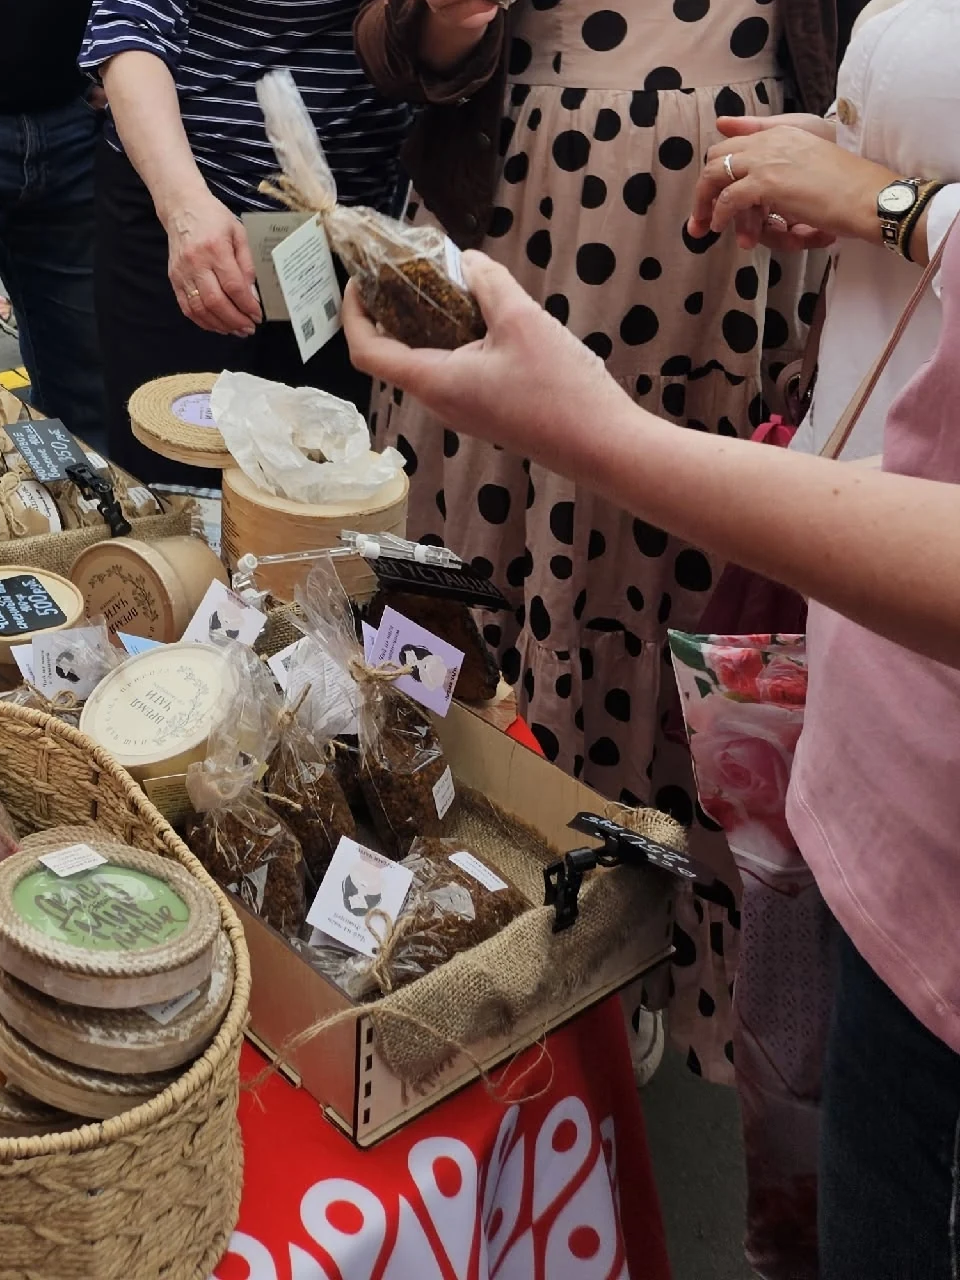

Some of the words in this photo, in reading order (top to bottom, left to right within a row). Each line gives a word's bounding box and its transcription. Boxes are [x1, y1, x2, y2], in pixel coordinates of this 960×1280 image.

[50, 440, 77, 465] 350
[27, 592, 59, 617] 500
[103, 597, 130, 621] ЧАГИ
[107, 606, 140, 636] ВРЕМЯ
[129, 697, 165, 725] ВРЕМЯ
[145, 689, 171, 713] ЧАГИ
